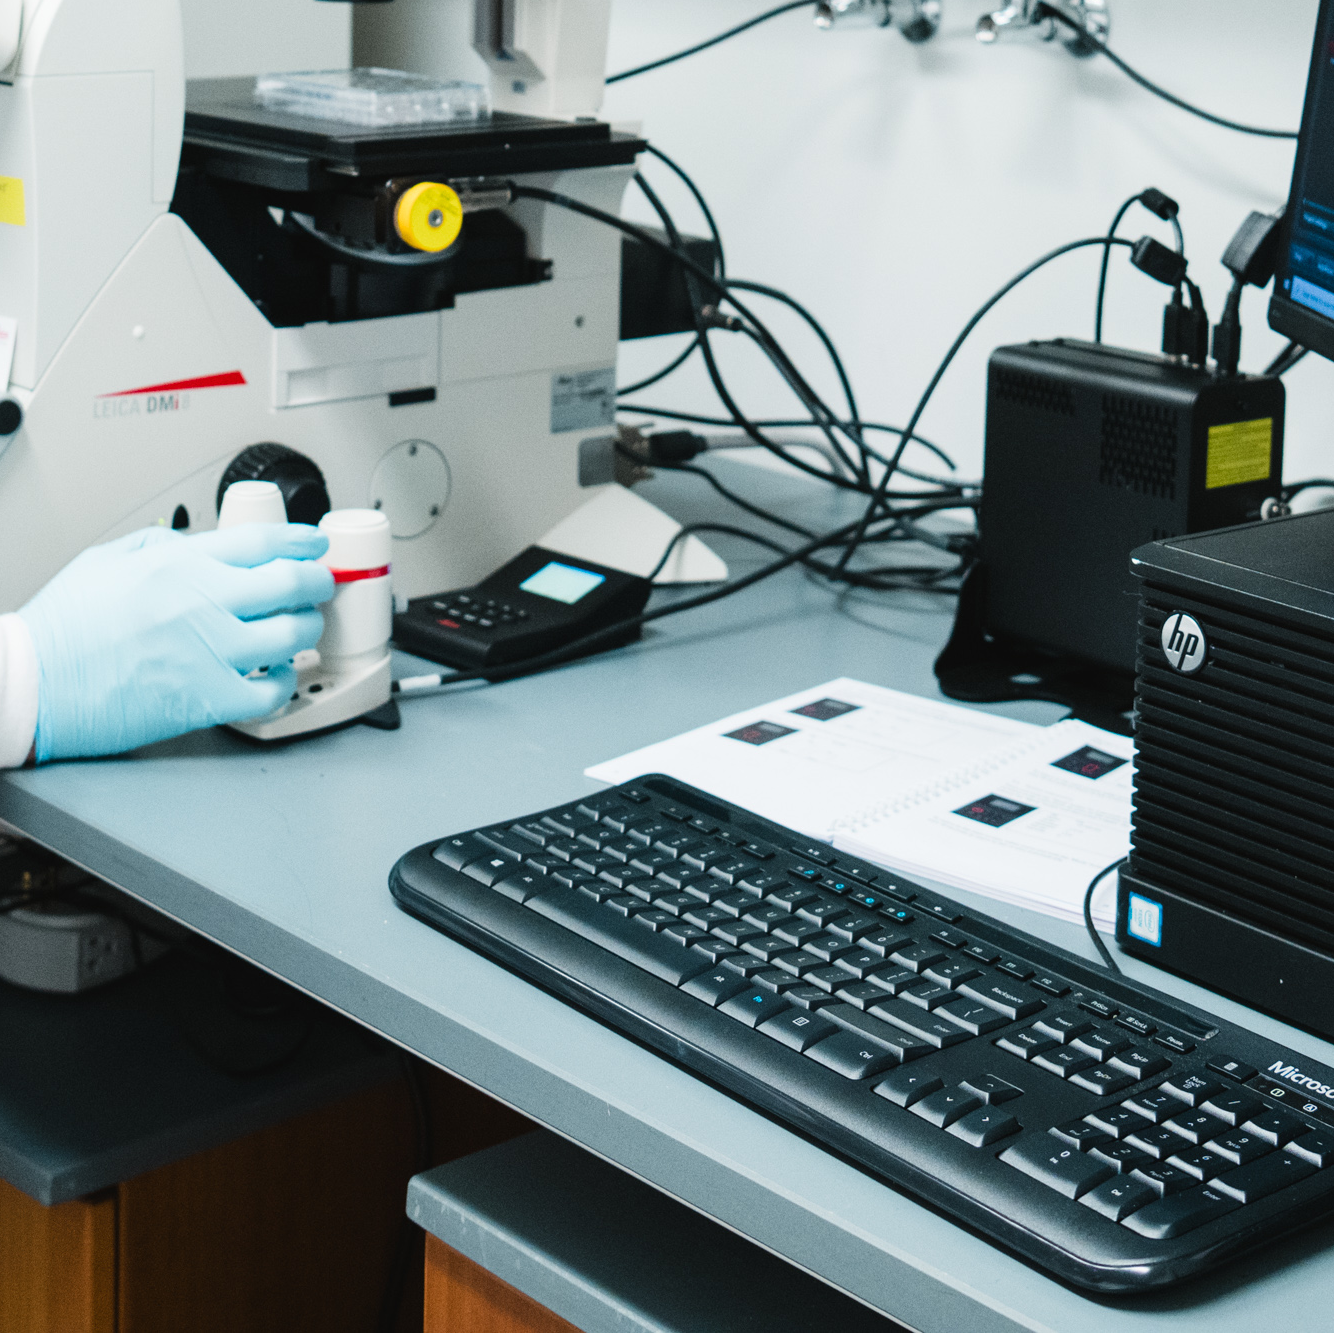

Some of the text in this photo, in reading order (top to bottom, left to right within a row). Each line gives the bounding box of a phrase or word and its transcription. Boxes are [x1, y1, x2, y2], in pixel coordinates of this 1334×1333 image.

[93, 398, 140, 419] LEICA
[1166, 613, 1201, 671] hp
[991, 987, 1024, 1004] Backspace
[1090, 1000, 1109, 1012] PrtScn
[1054, 1016, 1073, 1027] Insert
[933, 1024, 952, 1033] Enter
[1018, 1033, 1038, 1044] Delete
[1092, 1034, 1111, 1045] Home
[1166, 1036, 1184, 1047] Pause
[859, 1050, 874, 1060] Ctrl
[1059, 1053, 1073, 1061] End
[1131, 1052, 1149, 1063] PgUp
[1094, 1070, 1112, 1081] PgDn
[1190, 1075, 1207, 1086] Num
[1202, 1189, 1221, 1201] Enter
